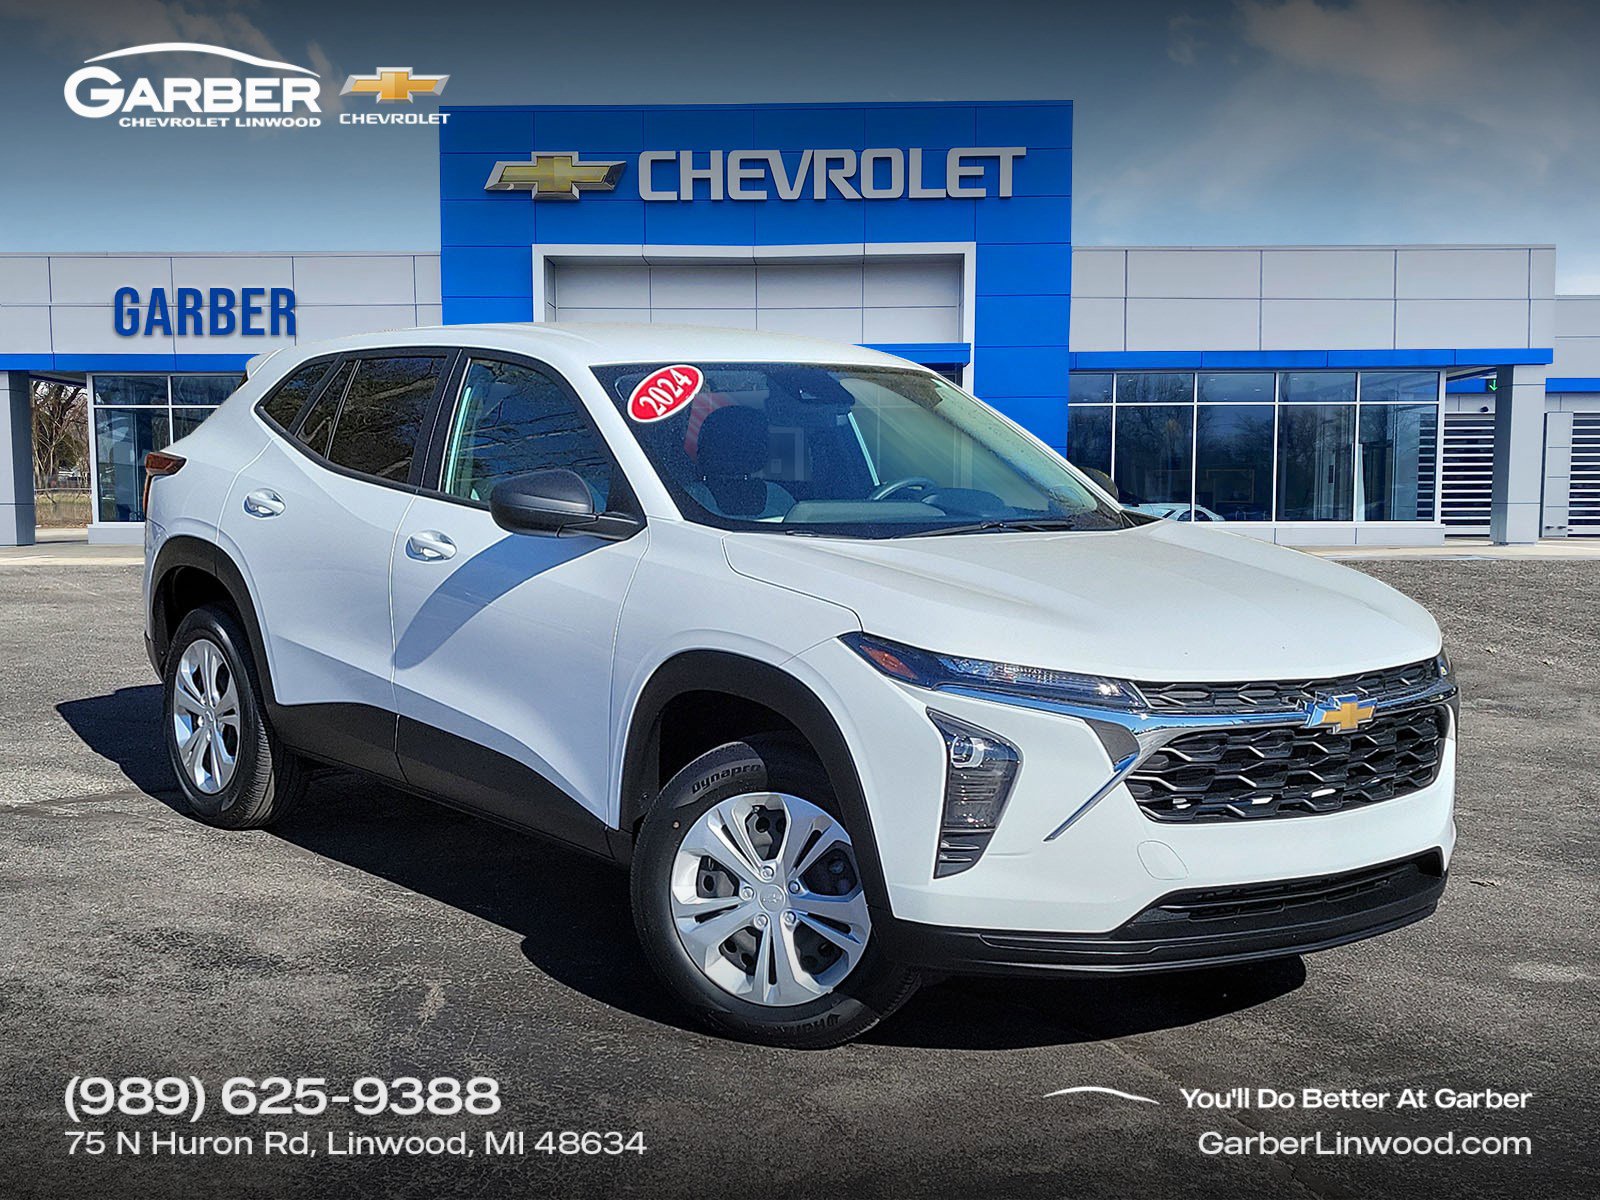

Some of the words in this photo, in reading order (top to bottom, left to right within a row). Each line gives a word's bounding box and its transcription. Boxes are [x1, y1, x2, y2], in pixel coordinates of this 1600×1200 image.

[638, 147, 1027, 201] CHEVROLET
[114, 287, 297, 337] GARBER
[639, 368, 693, 417] 2024
[692, 764, 761, 794] Dynapro
